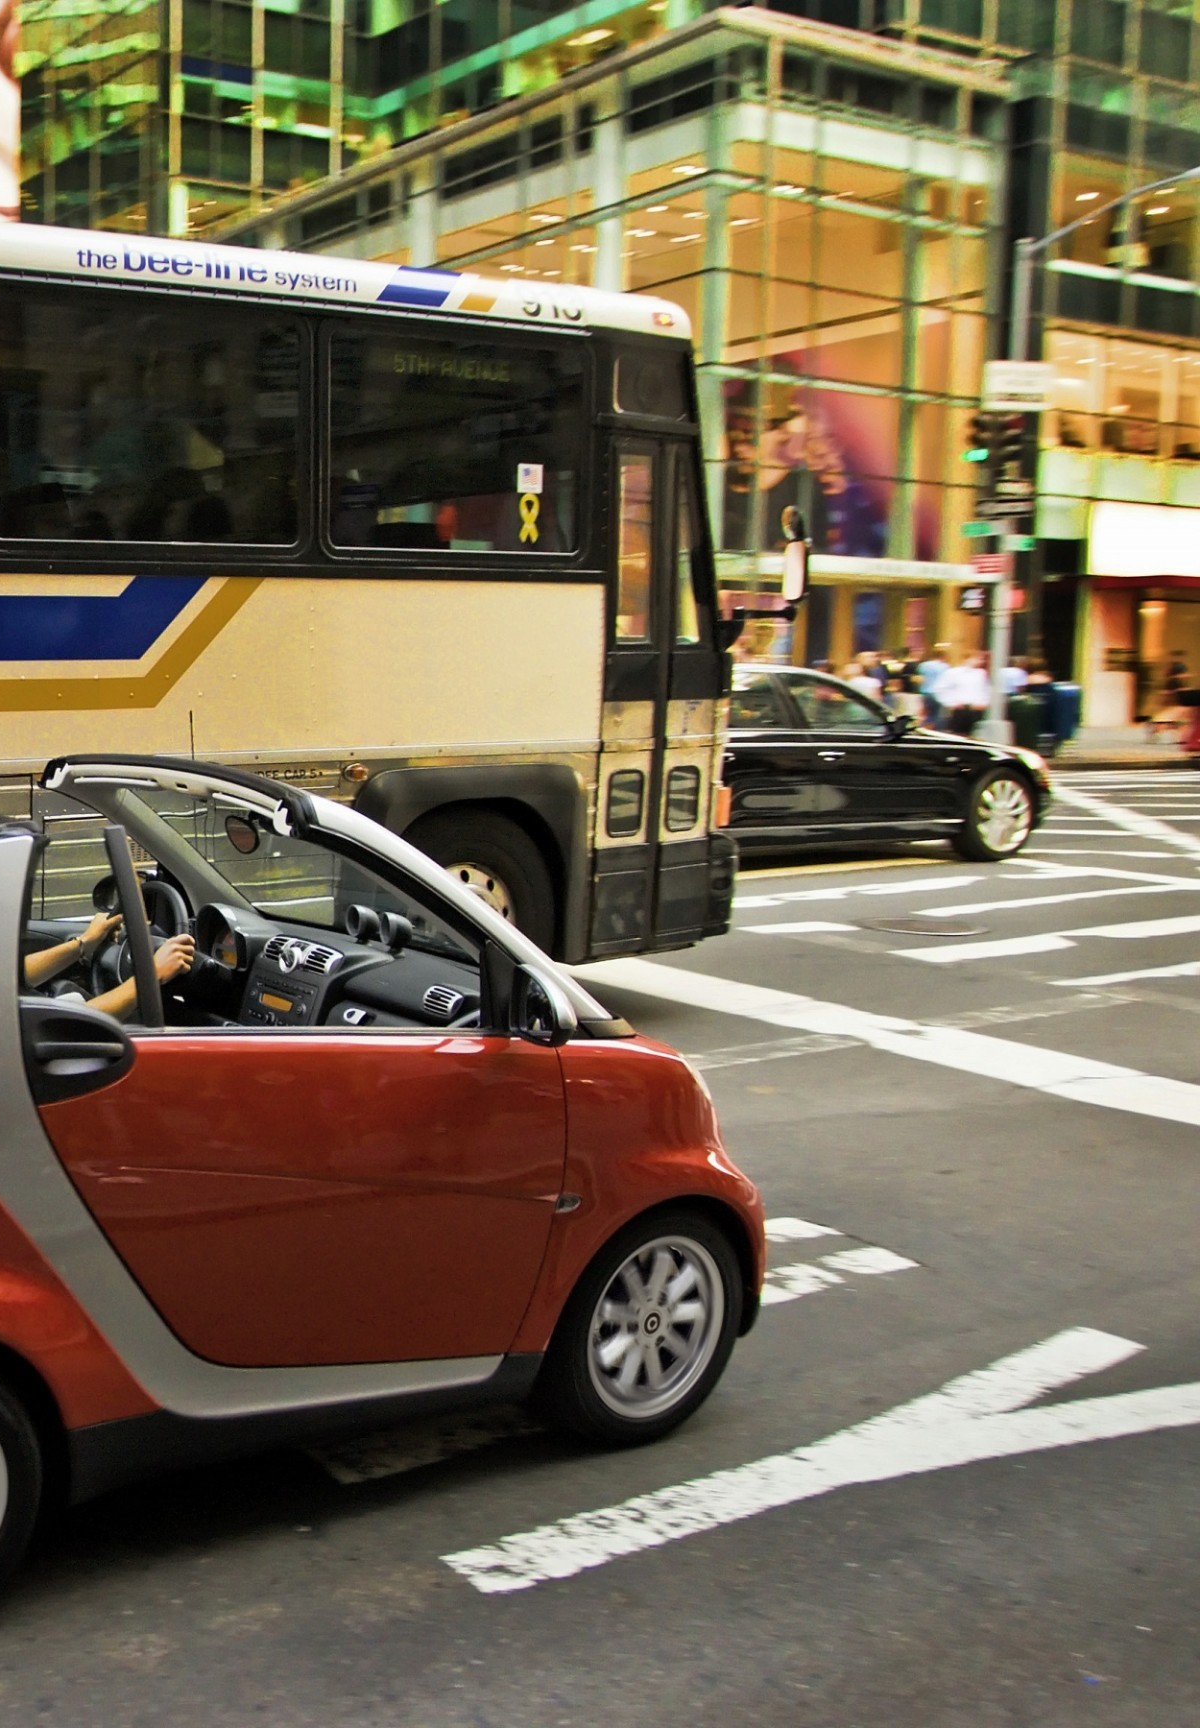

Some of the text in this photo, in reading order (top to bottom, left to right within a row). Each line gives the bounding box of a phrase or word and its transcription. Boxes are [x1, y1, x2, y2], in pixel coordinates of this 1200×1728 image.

[76, 243, 358, 293] the bee-line system
[393, 353, 431, 376] 5TH
